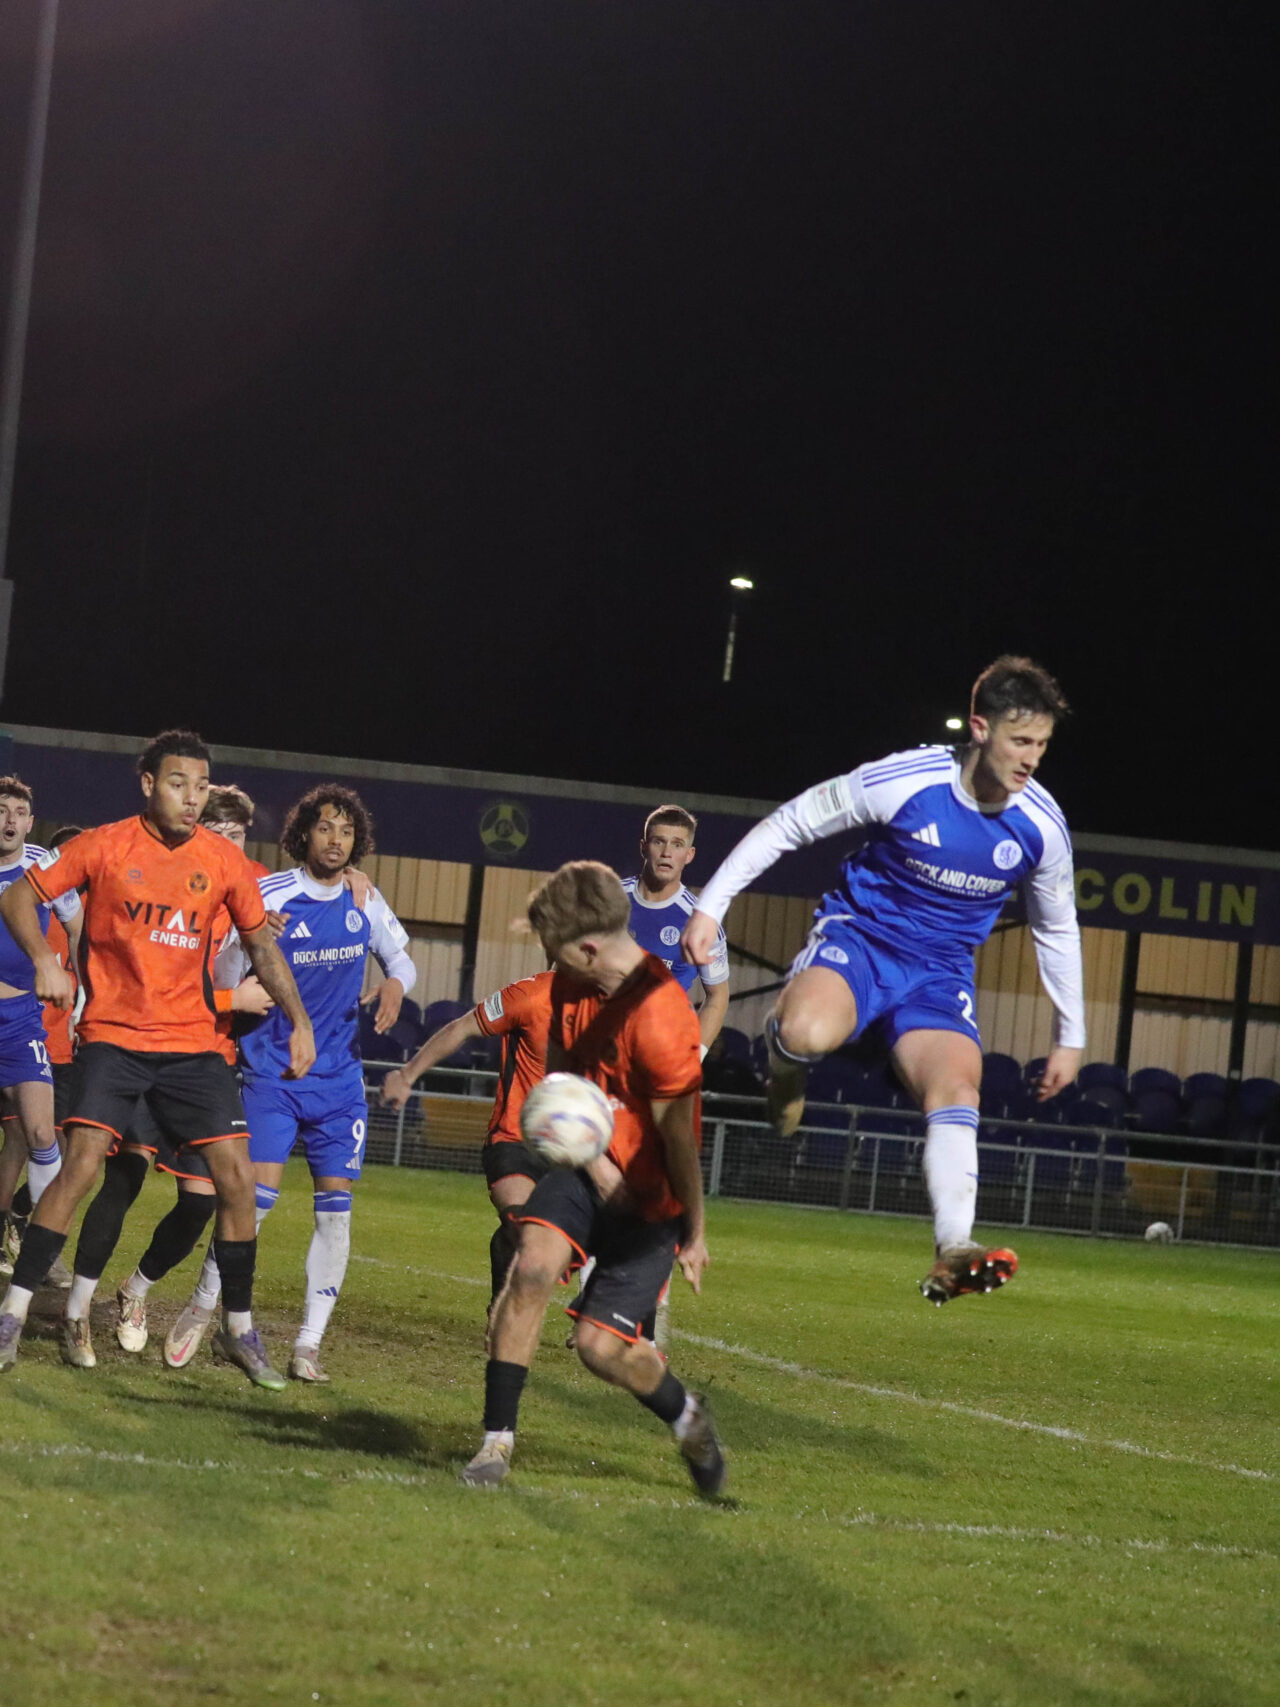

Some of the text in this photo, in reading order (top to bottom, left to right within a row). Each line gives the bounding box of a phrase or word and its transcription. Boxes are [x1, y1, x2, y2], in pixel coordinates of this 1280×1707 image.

[937, 868, 967, 888] AND
[1073, 868, 1257, 927] COLIN
[124, 900, 201, 934] VITAL
[319, 947, 339, 961] AND
[28, 1039, 51, 1067] 12
[352, 1118, 365, 1154] 9
